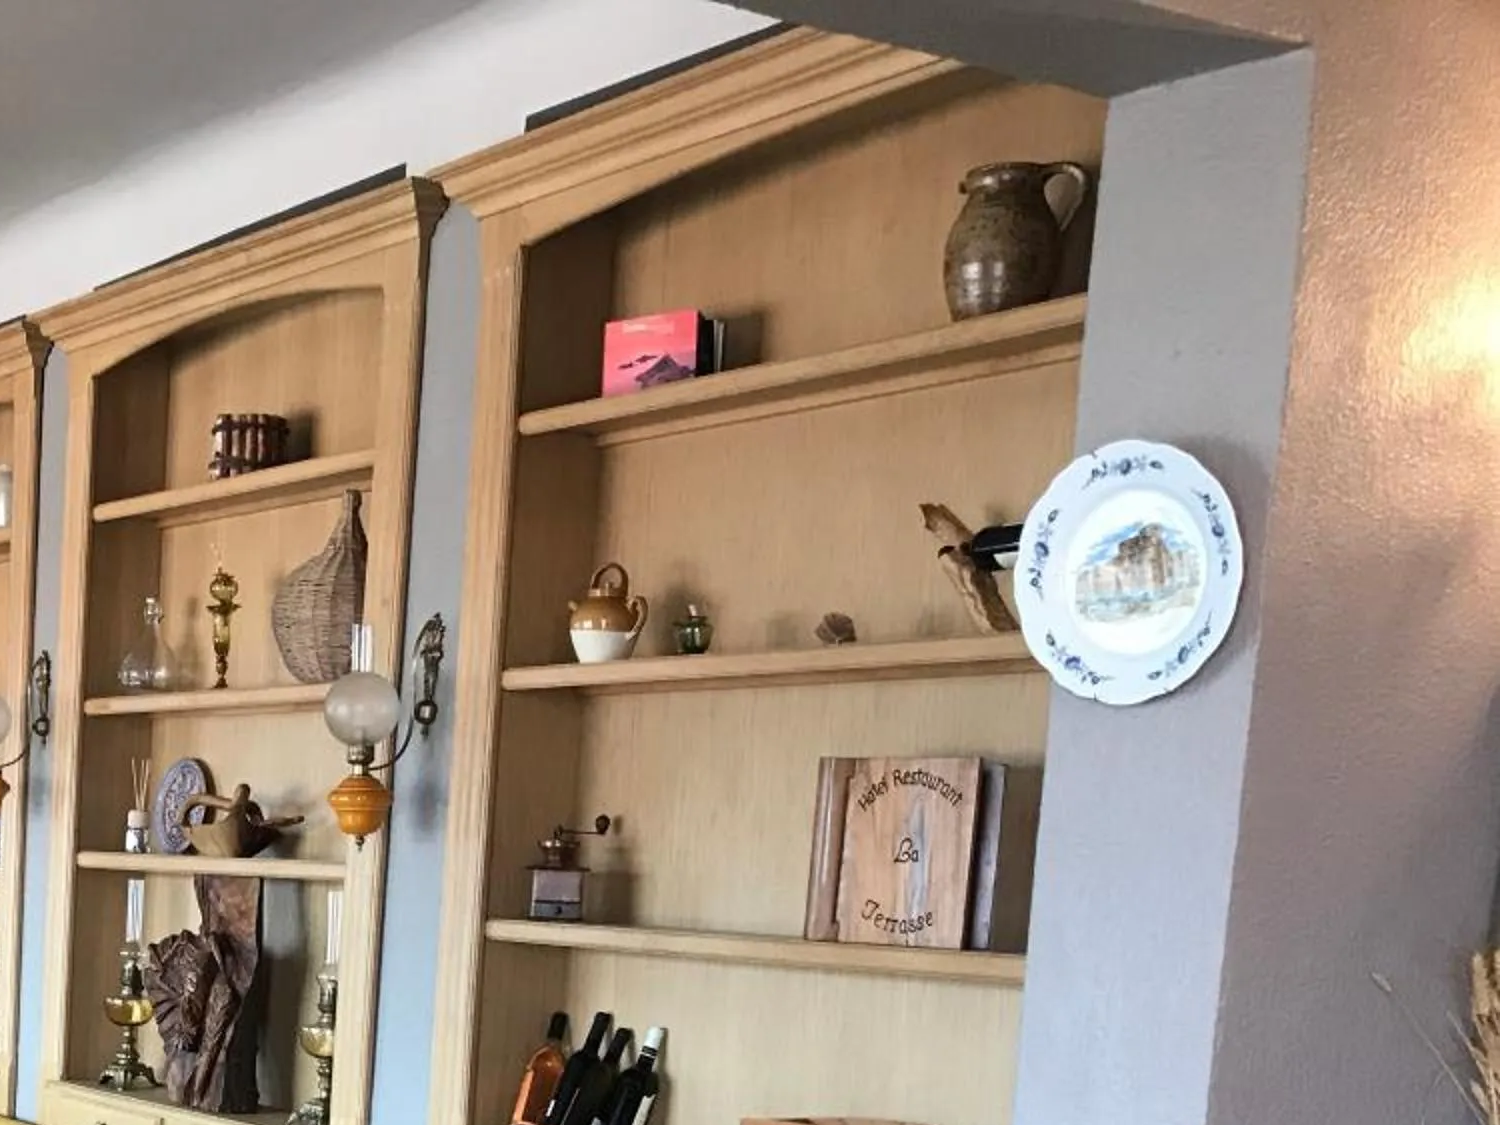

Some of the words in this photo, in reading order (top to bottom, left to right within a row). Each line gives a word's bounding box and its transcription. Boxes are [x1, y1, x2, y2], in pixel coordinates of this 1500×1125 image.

[893, 768, 963, 807] Restaurant
[894, 837, 919, 864] La
[861, 899, 933, 935] Terrasse
